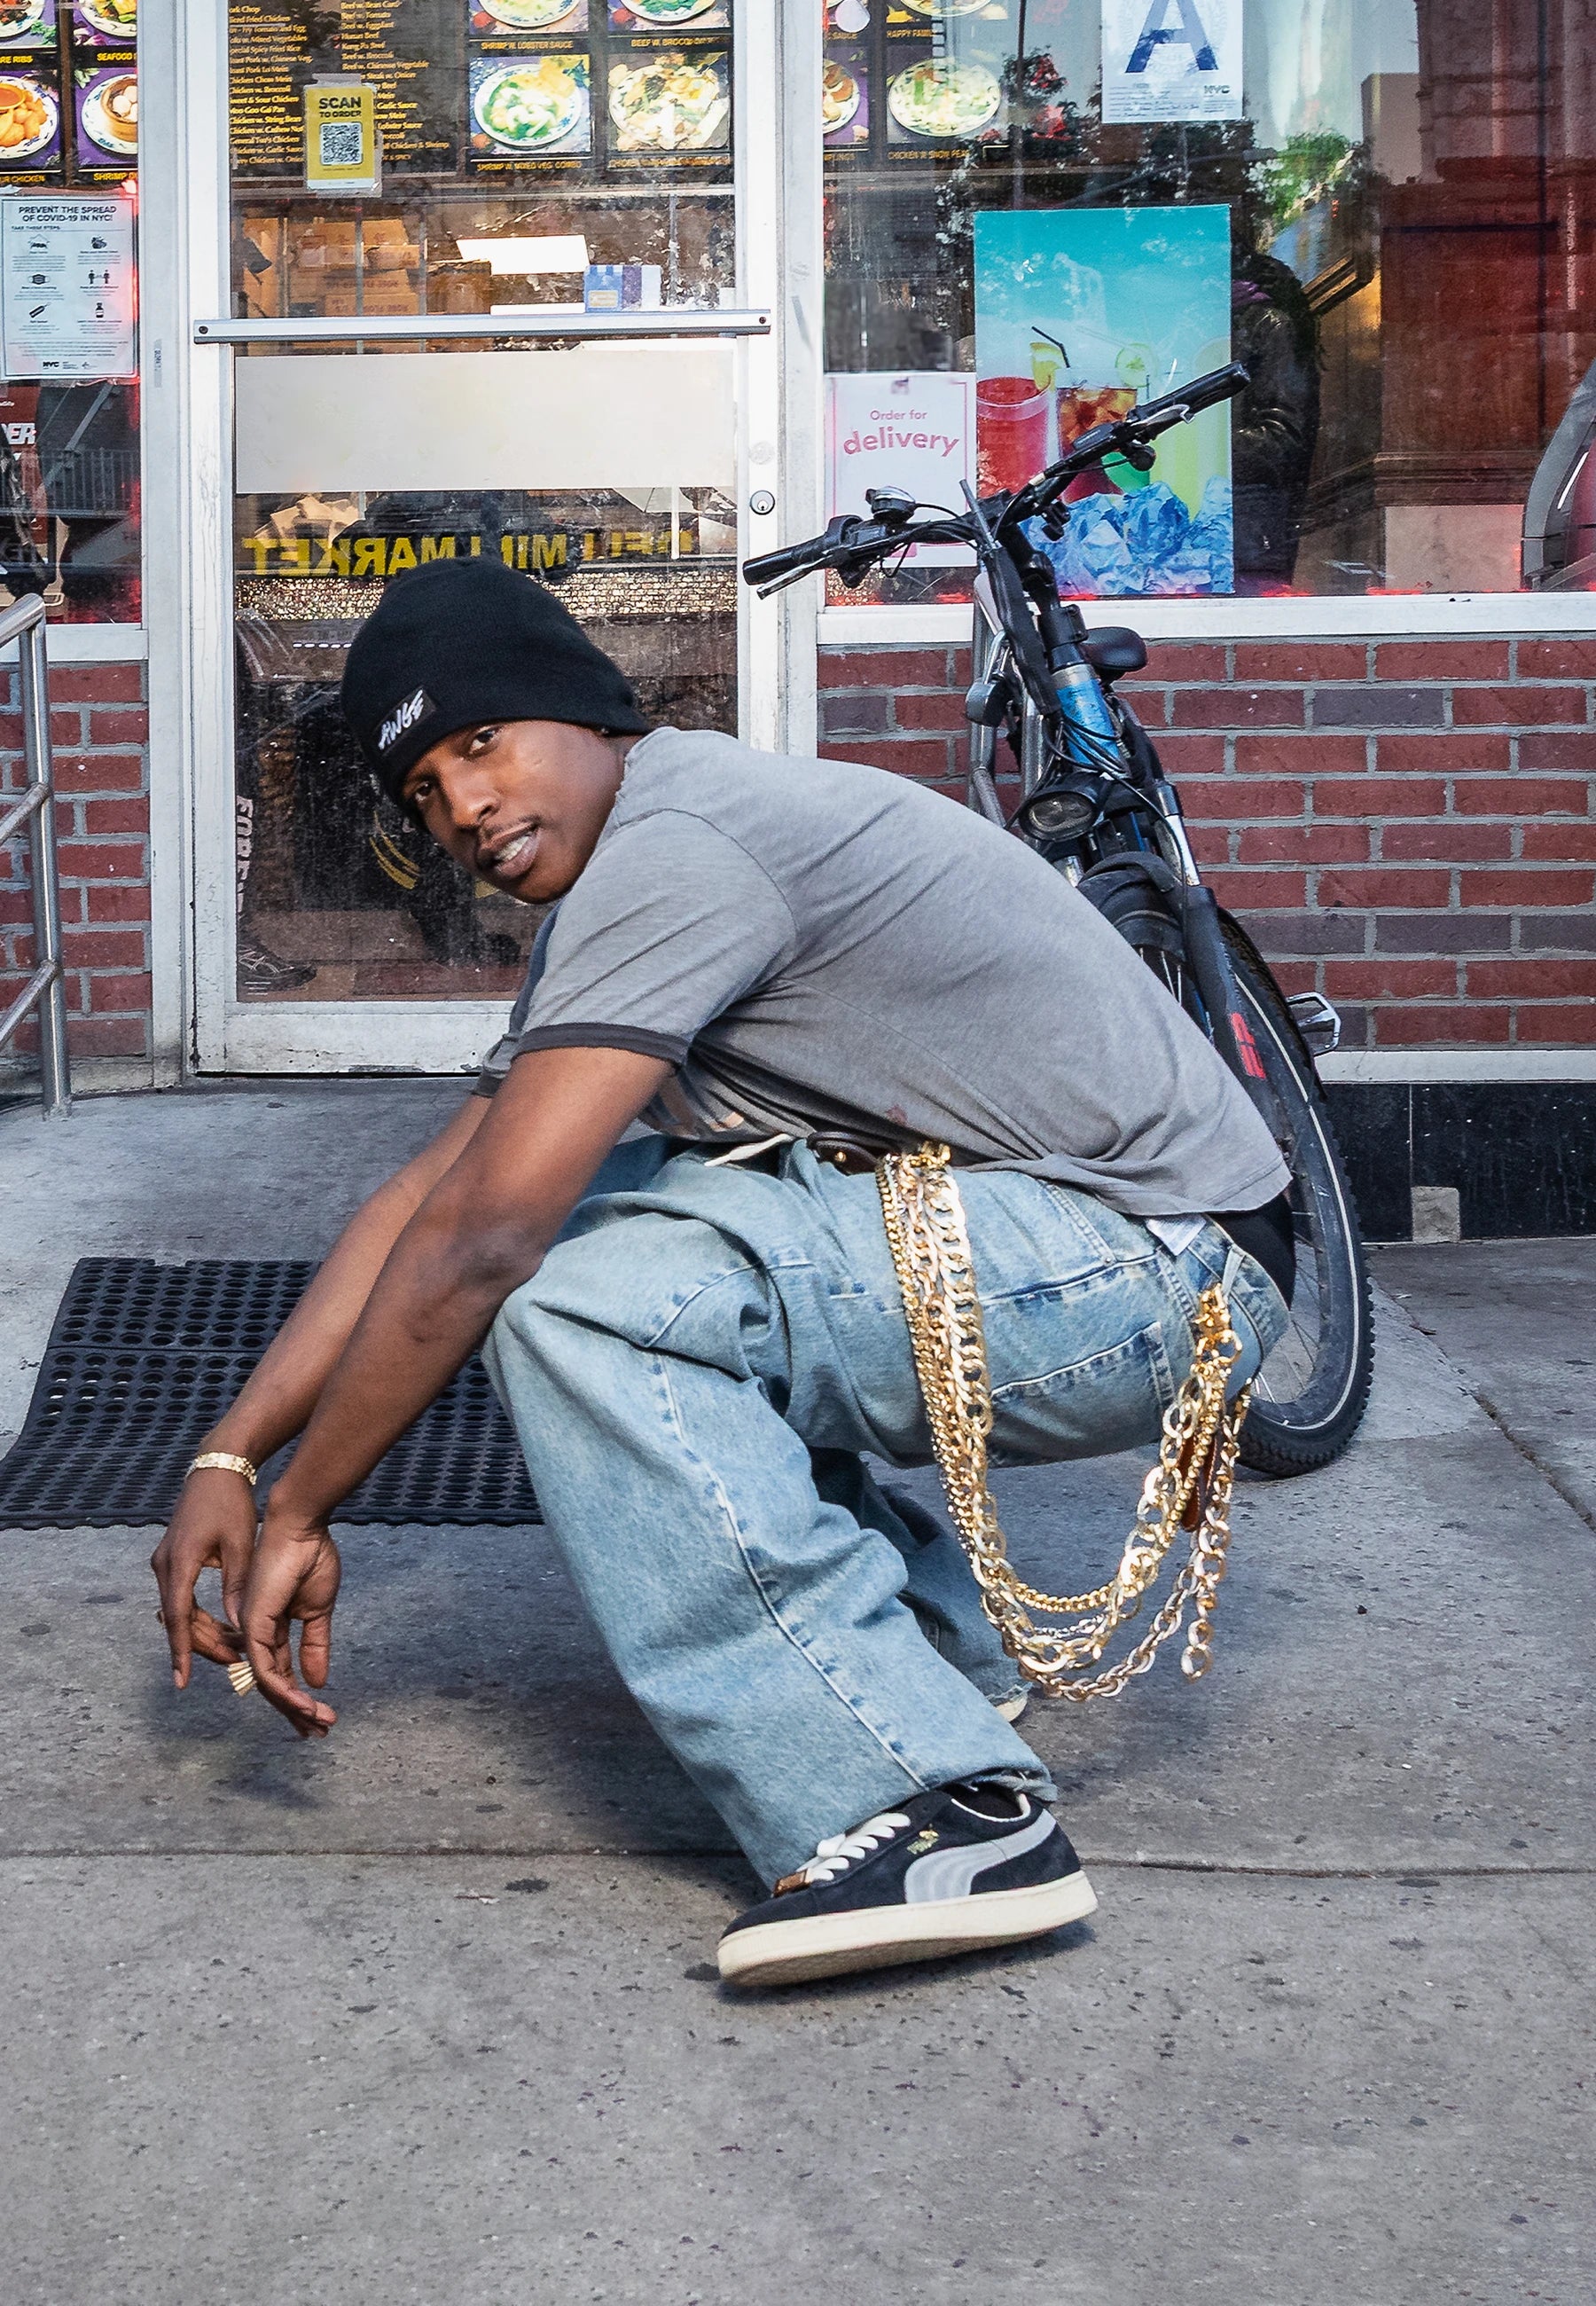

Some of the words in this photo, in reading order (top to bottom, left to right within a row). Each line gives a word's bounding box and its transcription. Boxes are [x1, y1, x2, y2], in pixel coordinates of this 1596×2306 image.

[1125, 0, 1218, 73] A
[550, 40, 574, 49] SAUCE
[97, 52, 133, 61] SEAFOOD
[1204, 85, 1231, 94] NYC
[319, 97, 361, 109] SCAN
[93, 172, 127, 181] SHRIMP
[870, 410, 906, 420] Order
[909, 409, 927, 420] for
[843, 426, 959, 457] delivery
